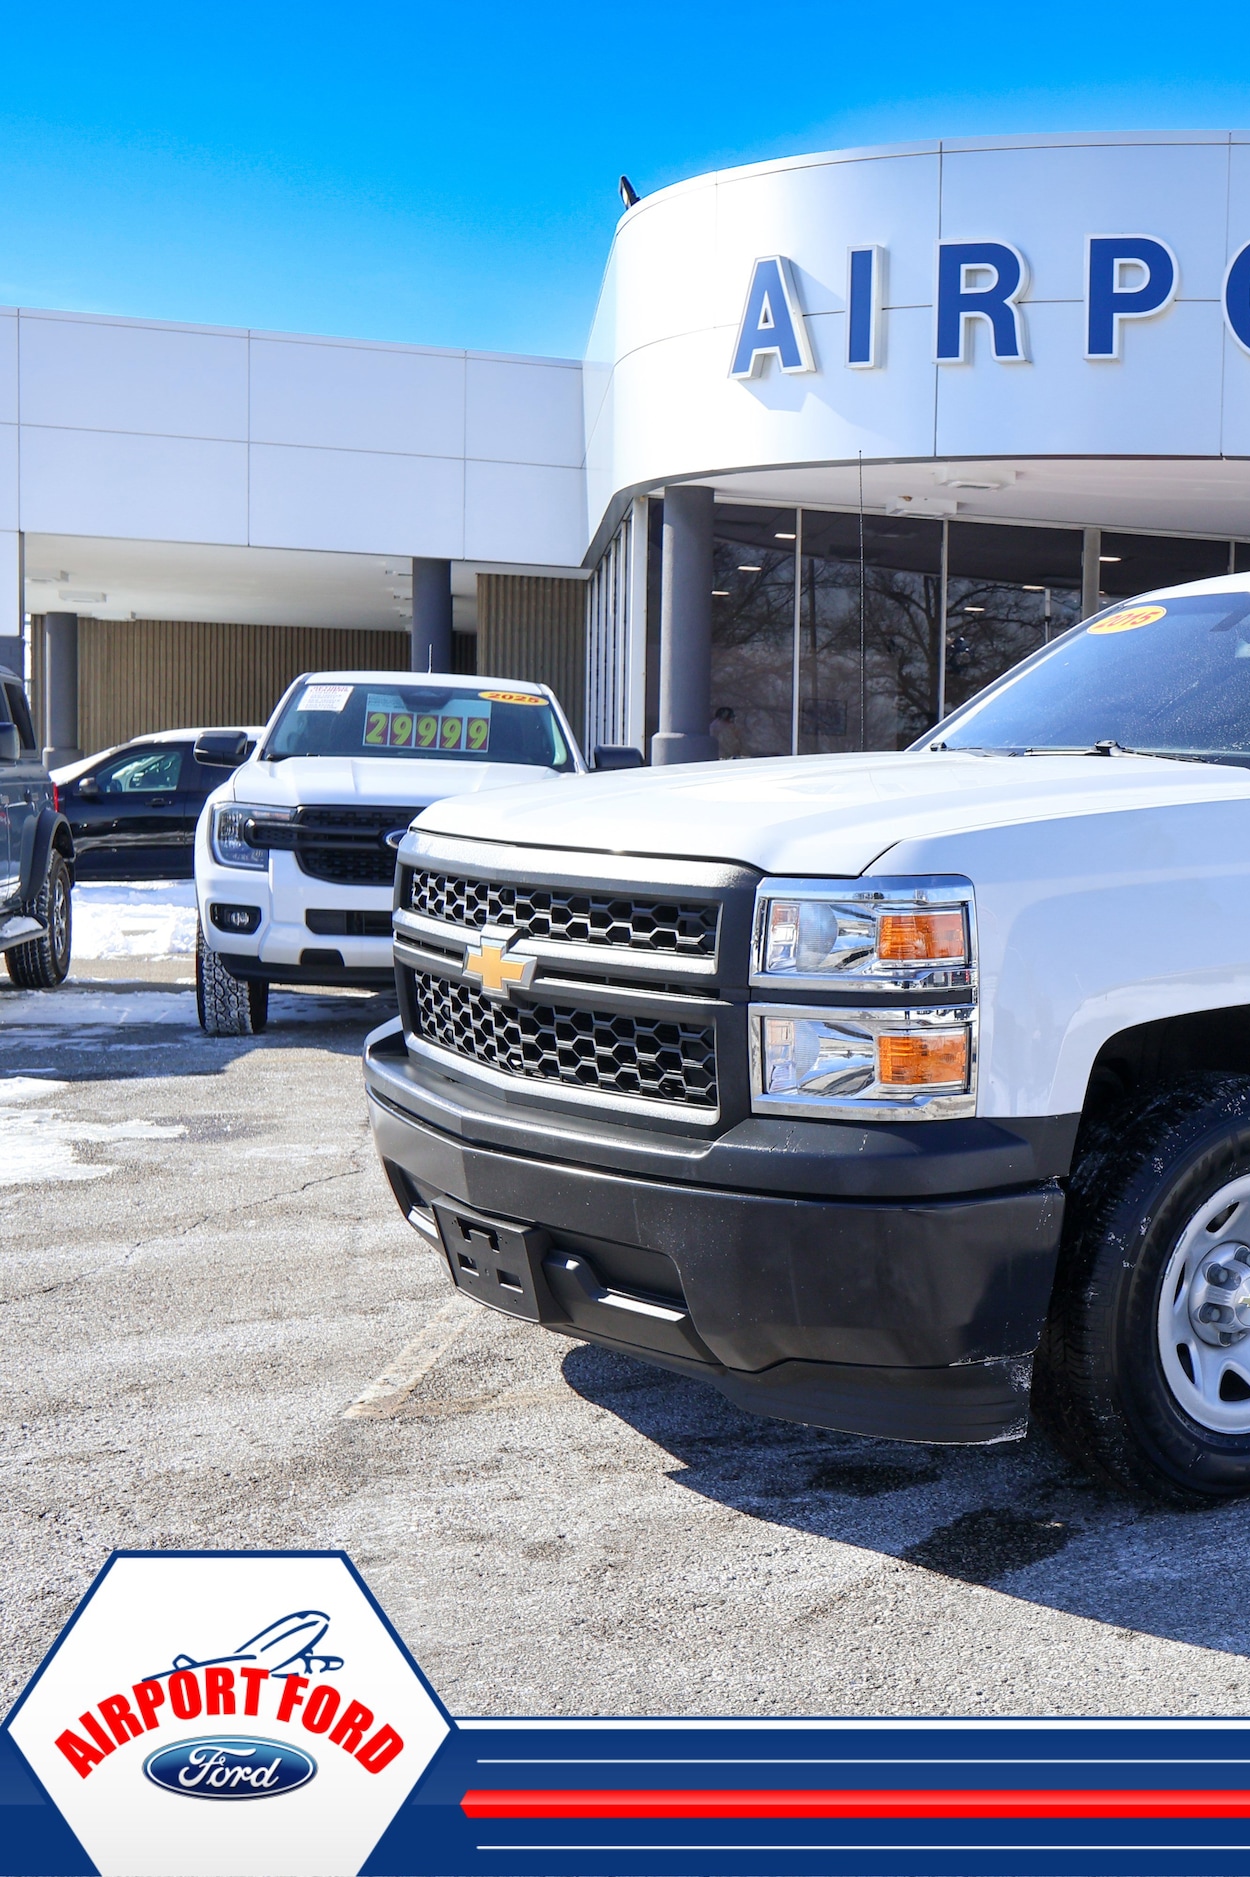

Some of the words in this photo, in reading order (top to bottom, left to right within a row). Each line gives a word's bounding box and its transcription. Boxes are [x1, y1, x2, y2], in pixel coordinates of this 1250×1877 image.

[1094, 610, 1162, 629] 2015
[487, 692, 541, 704] 2025
[365, 712, 488, 750] 29999
